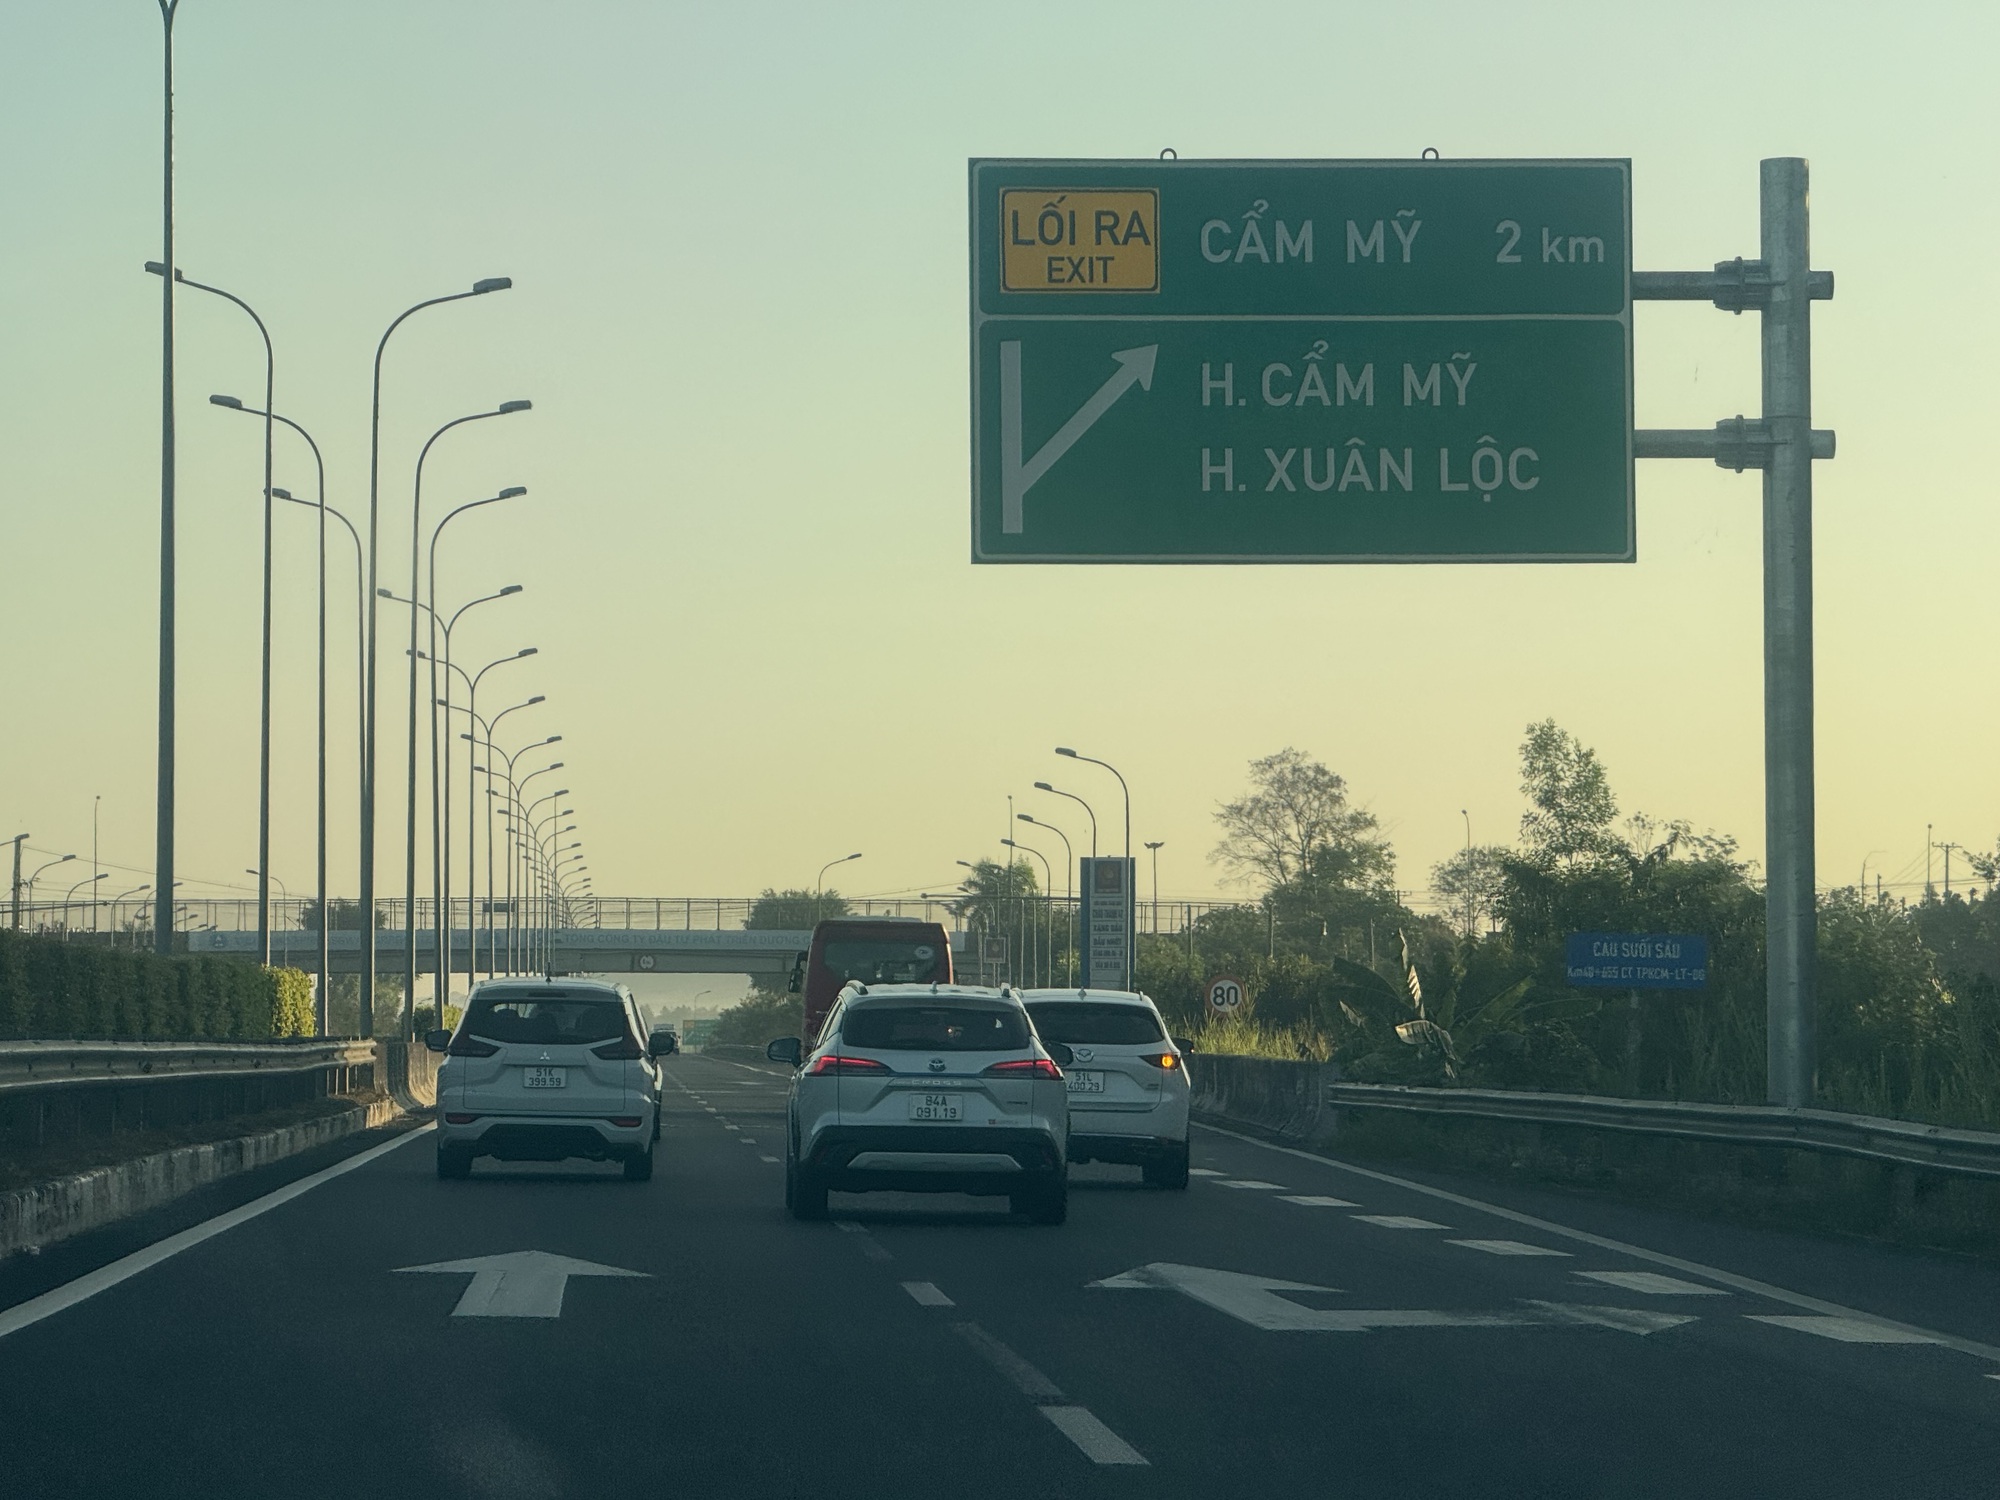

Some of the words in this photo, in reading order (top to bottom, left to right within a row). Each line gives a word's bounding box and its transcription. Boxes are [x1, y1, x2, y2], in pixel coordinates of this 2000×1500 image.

[1011, 195, 1076, 246] LỐI
[1095, 210, 1151, 246] RA
[1200, 200, 1314, 264] CẨM
[1346, 210, 1422, 264] MỸ
[1495, 219, 1522, 264] 2
[1542, 227, 1605, 263] km
[1047, 256, 1115, 284] EXIT
[1201, 362, 1247, 407] H.
[1261, 340, 1375, 407] CẨM
[1403, 352, 1478, 407] MỸ
[1201, 447, 1247, 492] H.
[1264, 437, 1413, 492] XUÂN
[1440, 436, 1540, 503] LỘC
[1213, 986, 1238, 1006] 80
[528, 1077, 562, 1087] 399.59
[536, 1068, 554, 1077] 51K
[1075, 1072, 1092, 1082] 51L
